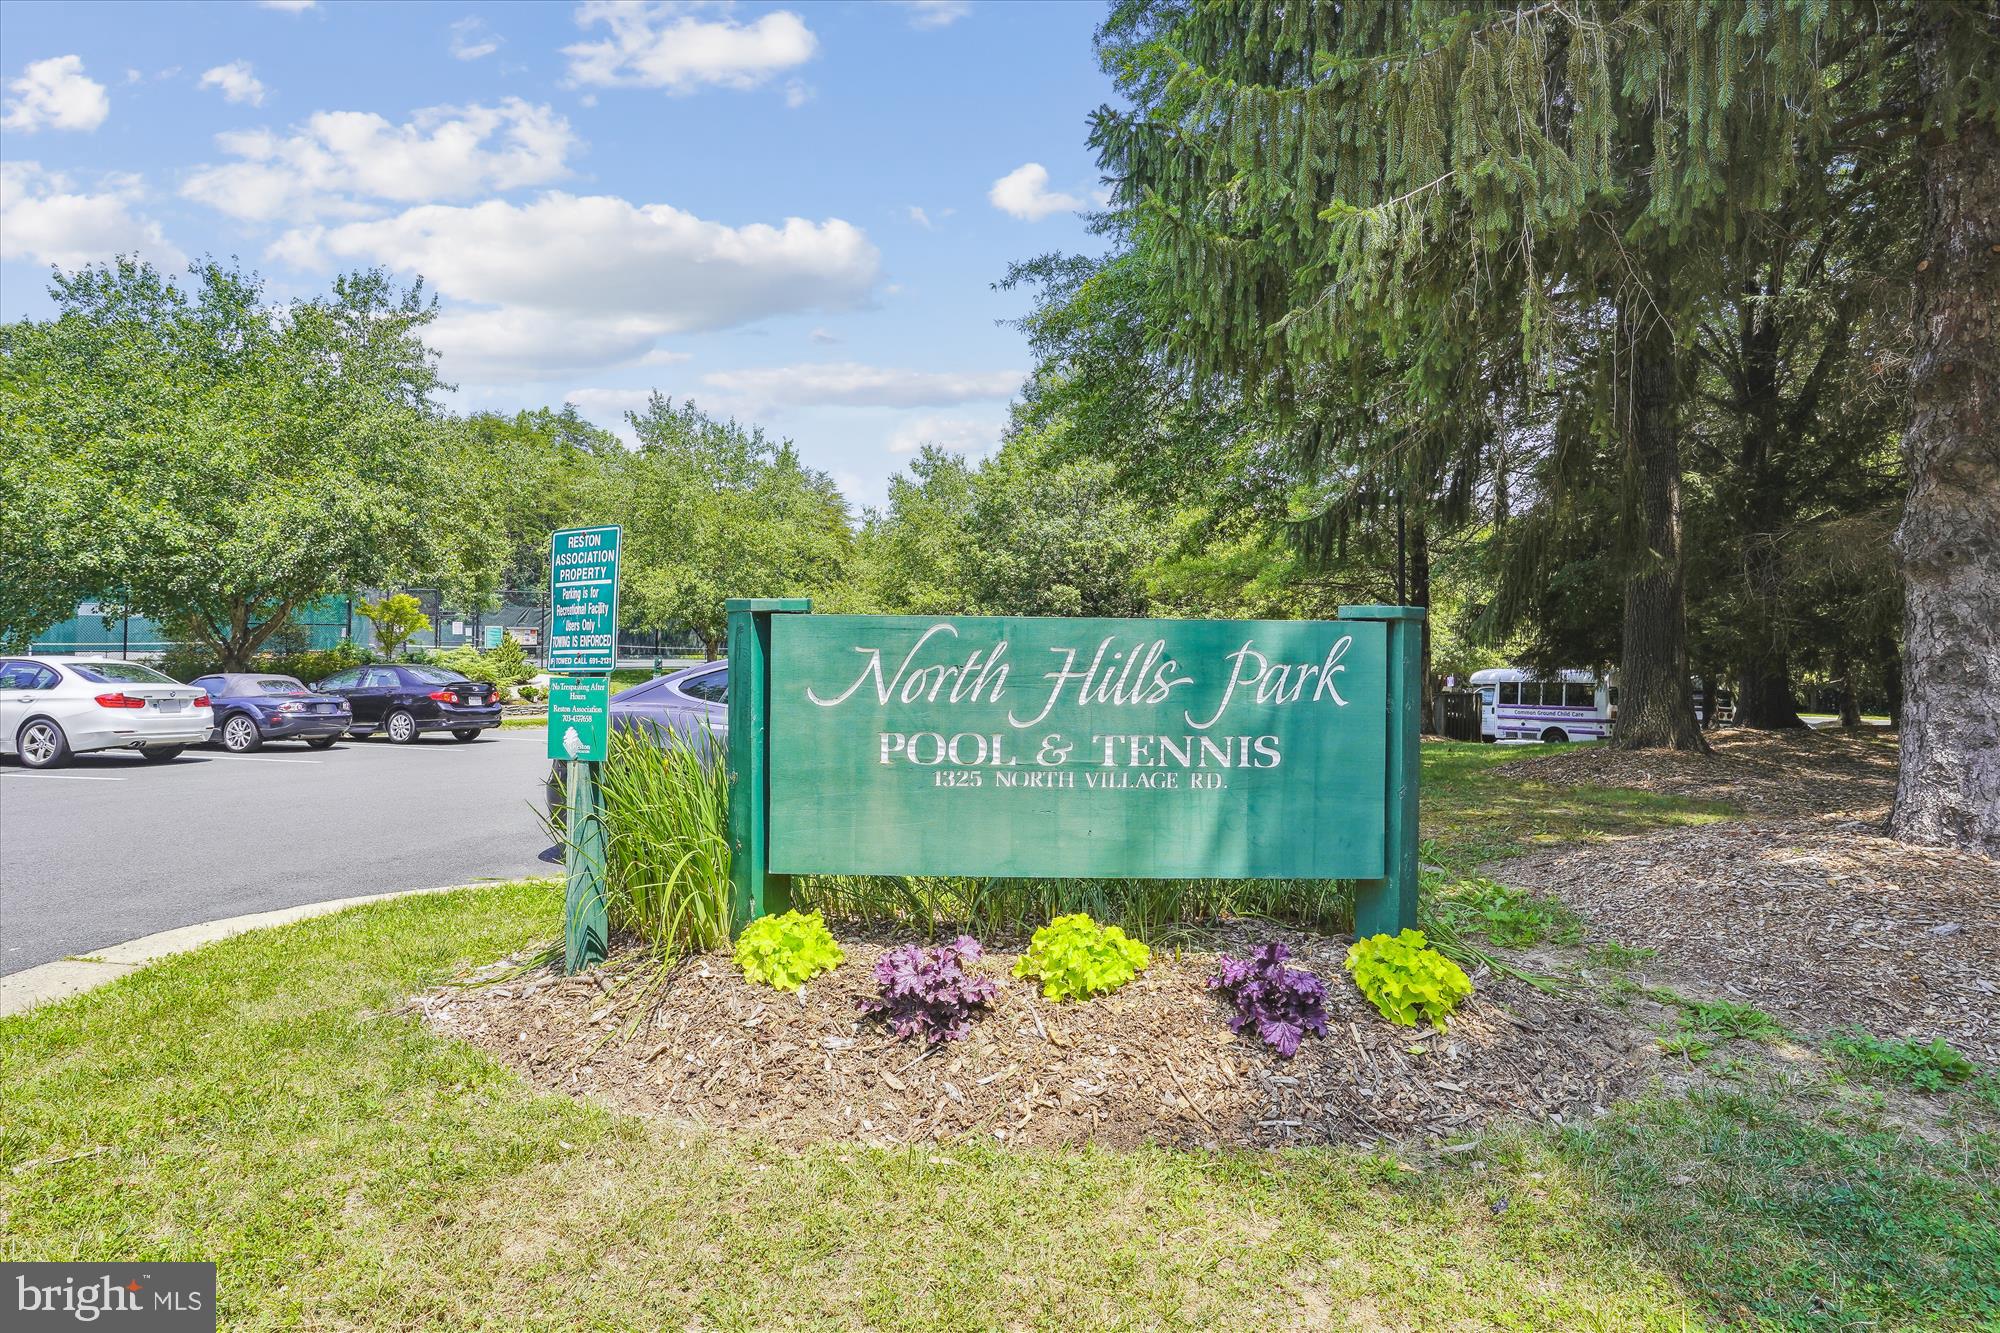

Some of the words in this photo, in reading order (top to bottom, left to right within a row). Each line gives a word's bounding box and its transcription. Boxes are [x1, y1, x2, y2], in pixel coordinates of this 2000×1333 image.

[568, 534, 601, 548] RESTON
[555, 549, 615, 566] ASSOCIATION
[560, 566, 607, 581] PROPERTY
[562, 587, 581, 602] Parking
[582, 586, 588, 599] is
[590, 586, 599, 598] for
[556, 603, 587, 617] Recreational
[588, 602, 609, 617] Facility
[565, 619, 580, 632] Users
[581, 618, 595, 634] Only
[552, 635, 570, 648] TOWING
[572, 635, 579, 647] IS
[580, 634, 612, 647] ENFORCED
[555, 657, 572, 665] TOWED
[573, 657, 587, 665] CALL
[807, 623, 1009, 706] North
[1008, 635, 1194, 728] Hills
[1184, 635, 1353, 729] Park
[552, 683, 560, 691] No
[560, 683, 590, 692] Trespassing
[590, 683, 605, 691] After
[570, 692, 586, 700] Hours
[553, 704, 571, 713] Reston
[572, 704, 603, 713] Association
[879, 732, 1016, 766] POOL
[1036, 733, 1073, 766] &
[1093, 735, 1281, 768] TENNIS
[933, 770, 982, 787] 1325
[996, 771, 1074, 788] NORTH
[1085, 772, 1178, 788] VILLAGE
[1191, 773, 1228, 789] RD.
